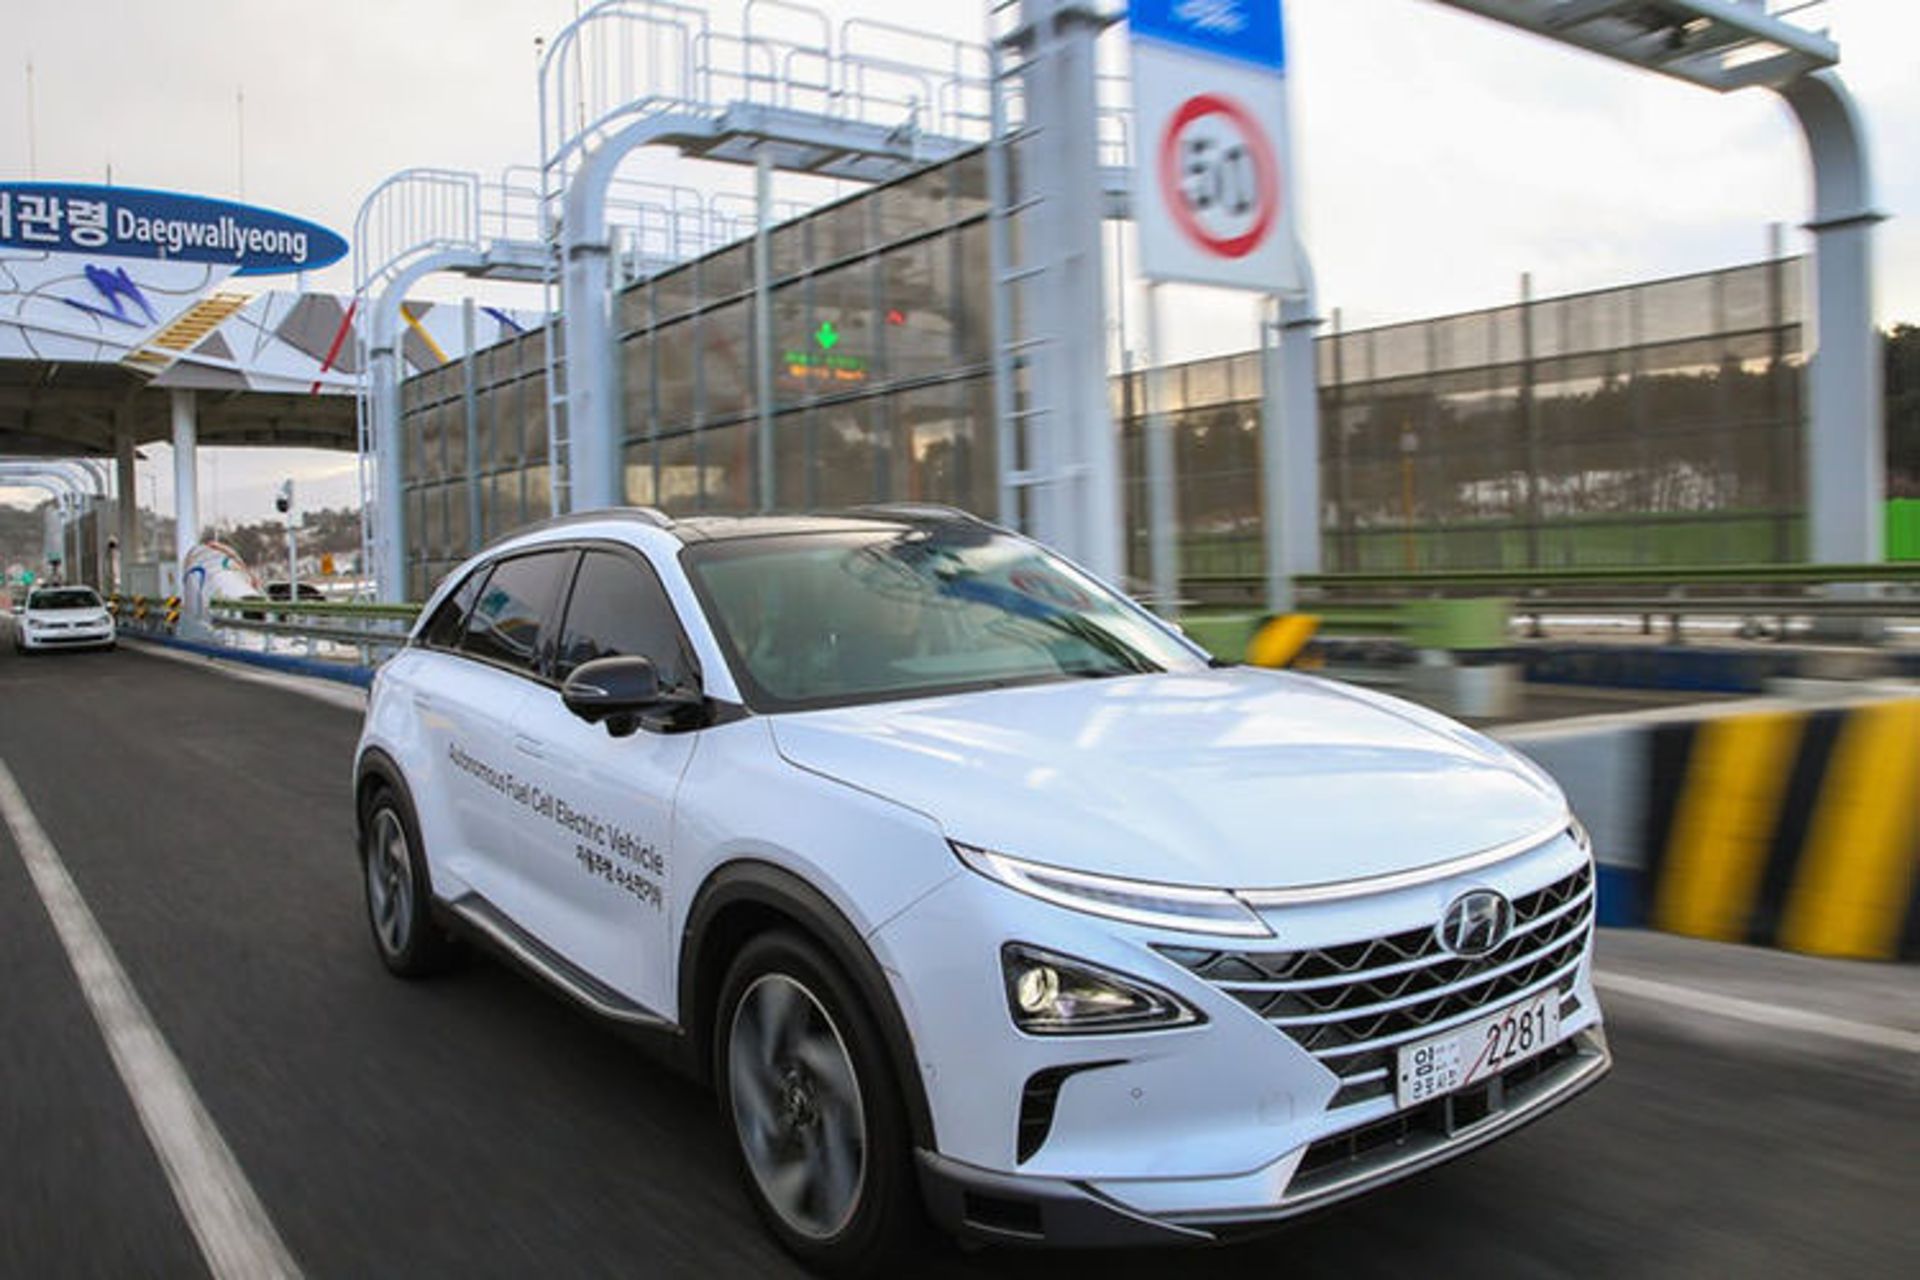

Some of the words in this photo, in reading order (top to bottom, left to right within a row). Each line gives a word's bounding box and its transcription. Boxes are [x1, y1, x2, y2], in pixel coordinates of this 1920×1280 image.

[116, 207, 308, 264] Daegwallyeong
[449, 742, 506, 795] Autonomous
[507, 774, 530, 805] Fuel
[532, 786, 554, 819] Cell
[556, 799, 605, 846] Electric
[607, 823, 664, 876] Vehicle
[1486, 1004, 1546, 1067] 2281
